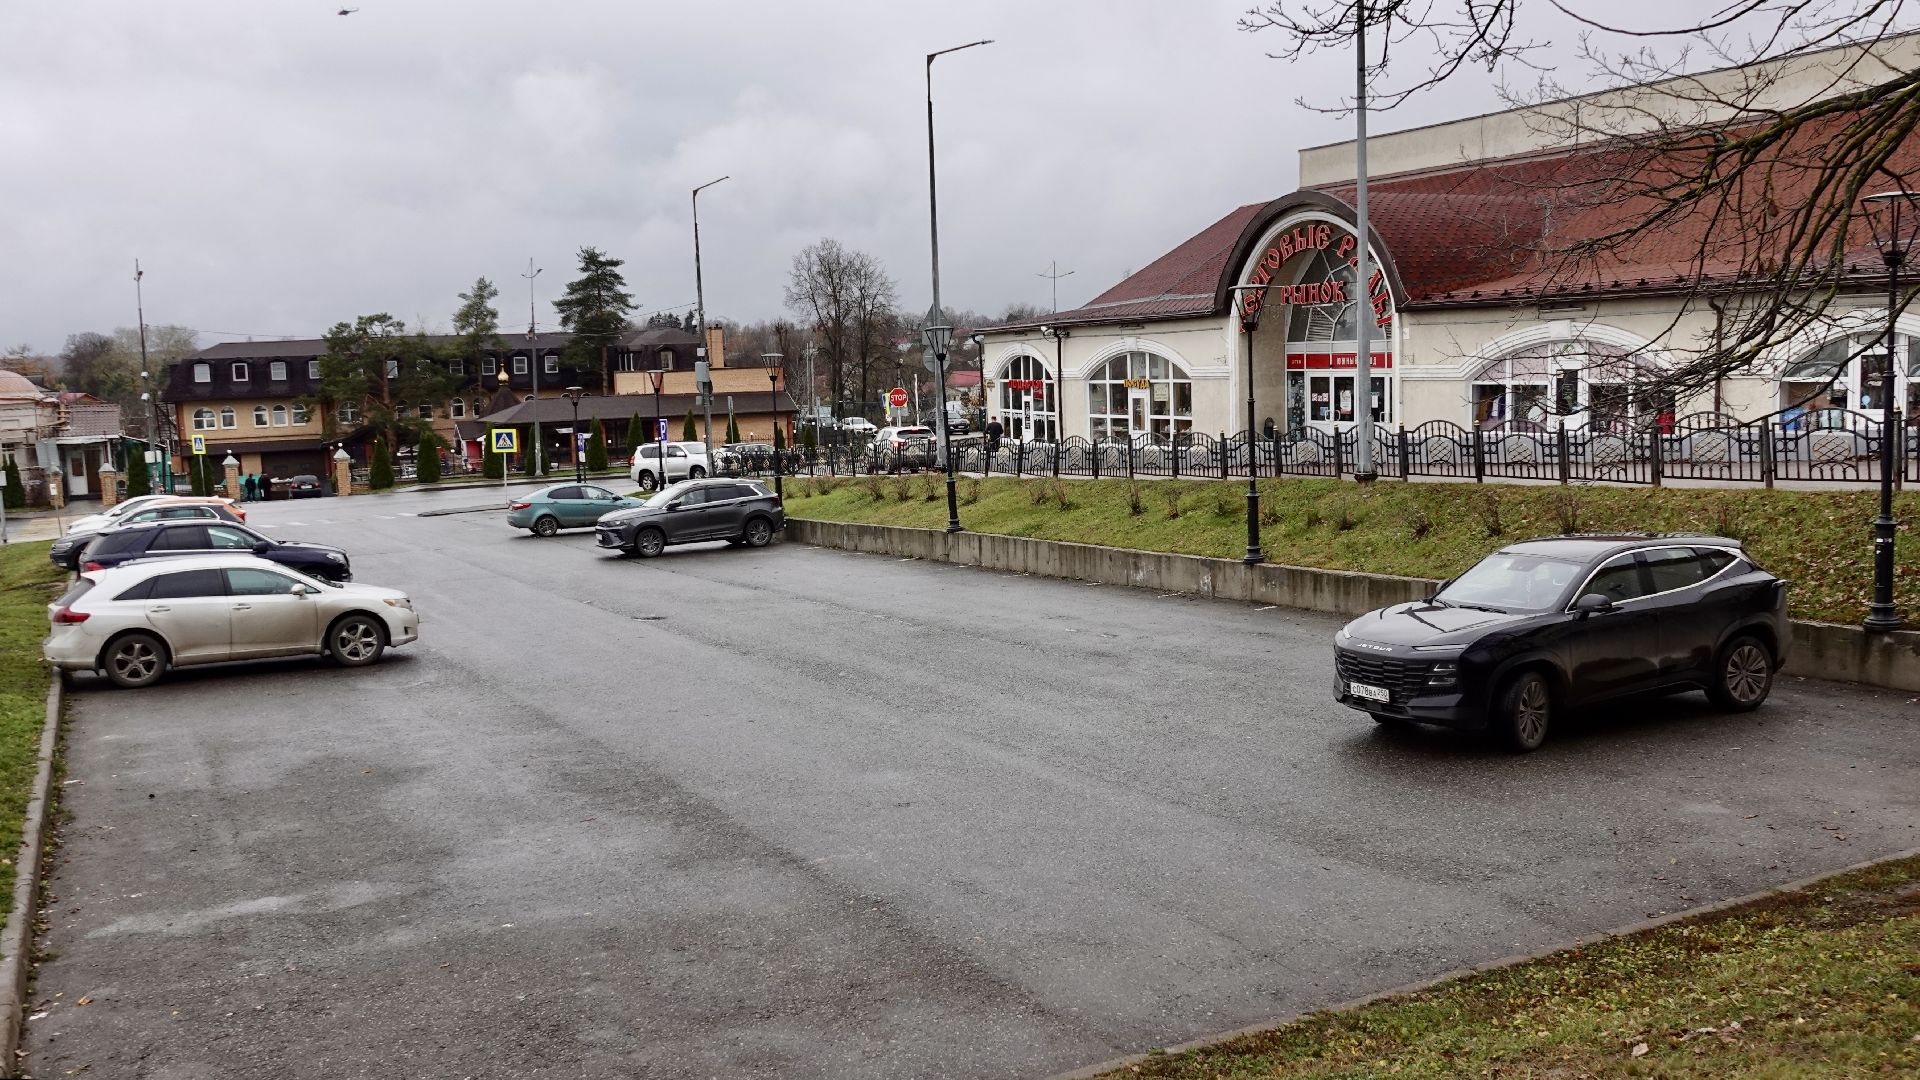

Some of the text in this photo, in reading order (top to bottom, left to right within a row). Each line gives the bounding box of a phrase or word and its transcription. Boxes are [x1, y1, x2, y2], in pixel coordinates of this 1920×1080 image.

[1280, 281, 1346, 305] РЫНОК
[1337, 234, 1393, 328] РЫ
[890, 394, 907, 402] STOP
